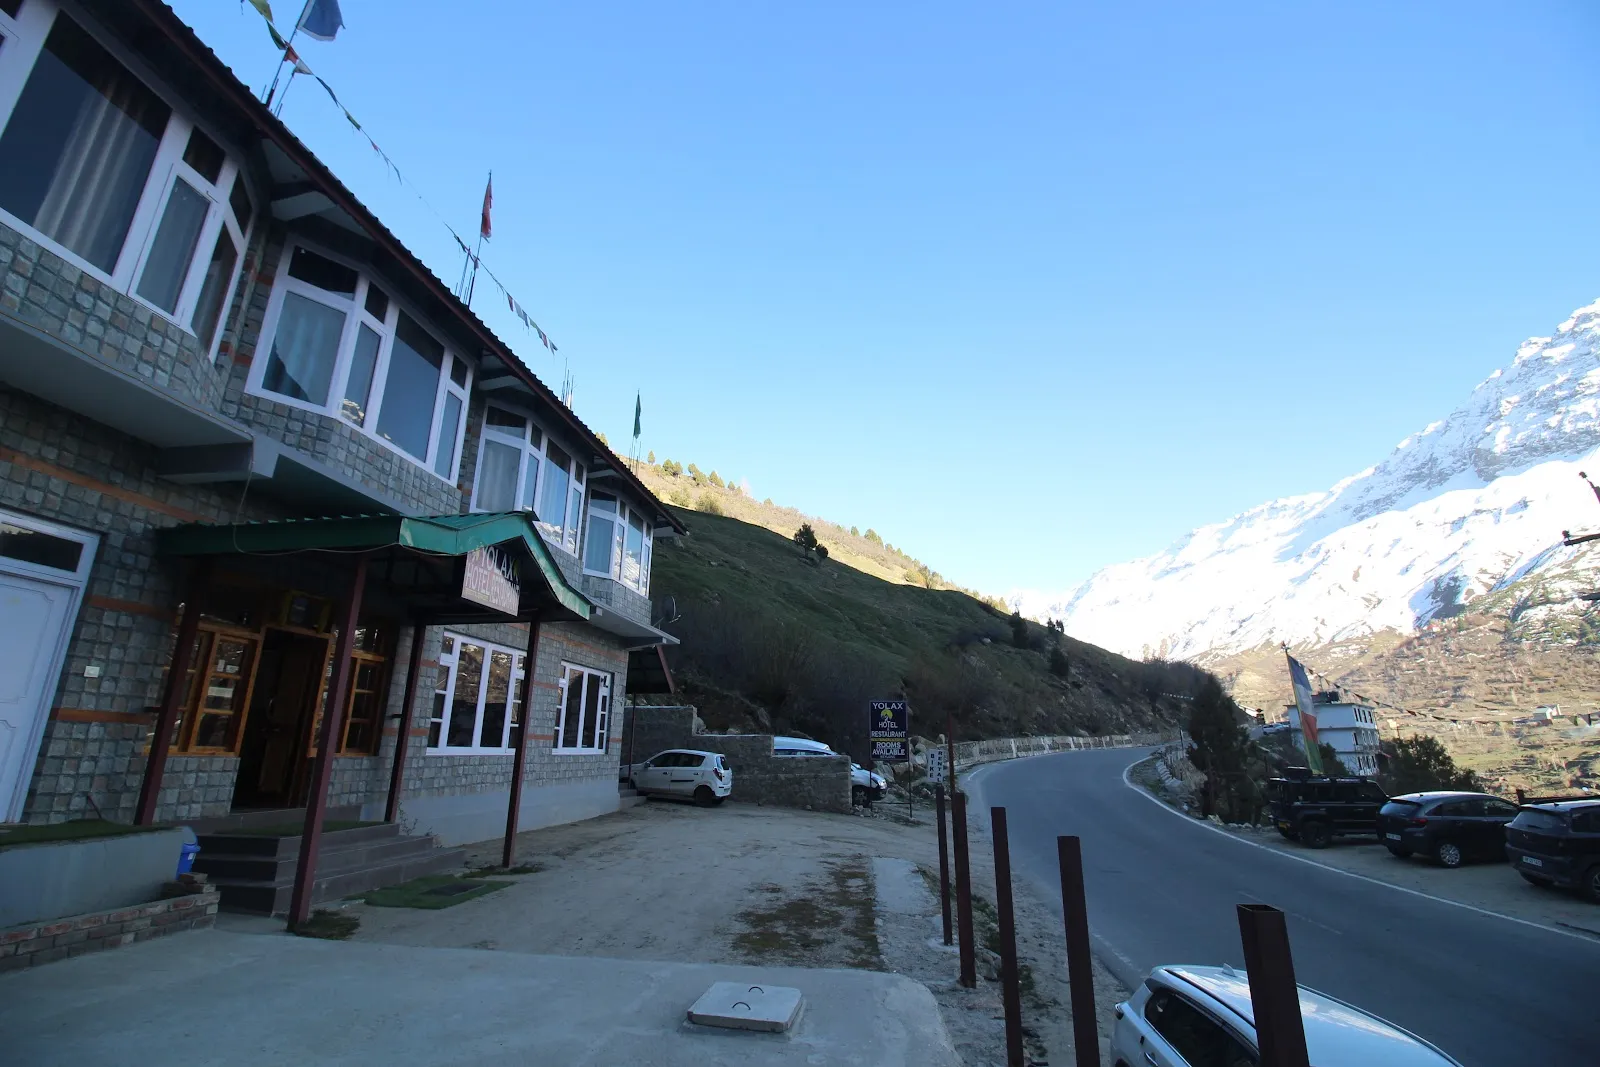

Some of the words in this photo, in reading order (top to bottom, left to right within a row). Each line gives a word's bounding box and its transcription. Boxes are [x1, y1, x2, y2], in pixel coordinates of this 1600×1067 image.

[481, 545, 515, 581] YOLAX
[465, 562, 490, 595] HOTEL
[872, 702, 903, 710] YOLAX
[878, 720, 898, 728] HOTEL
[871, 730, 906, 738] RESTAURANT
[876, 741, 901, 749] ROOMS
[872, 748, 905, 756] AVAILABLE
